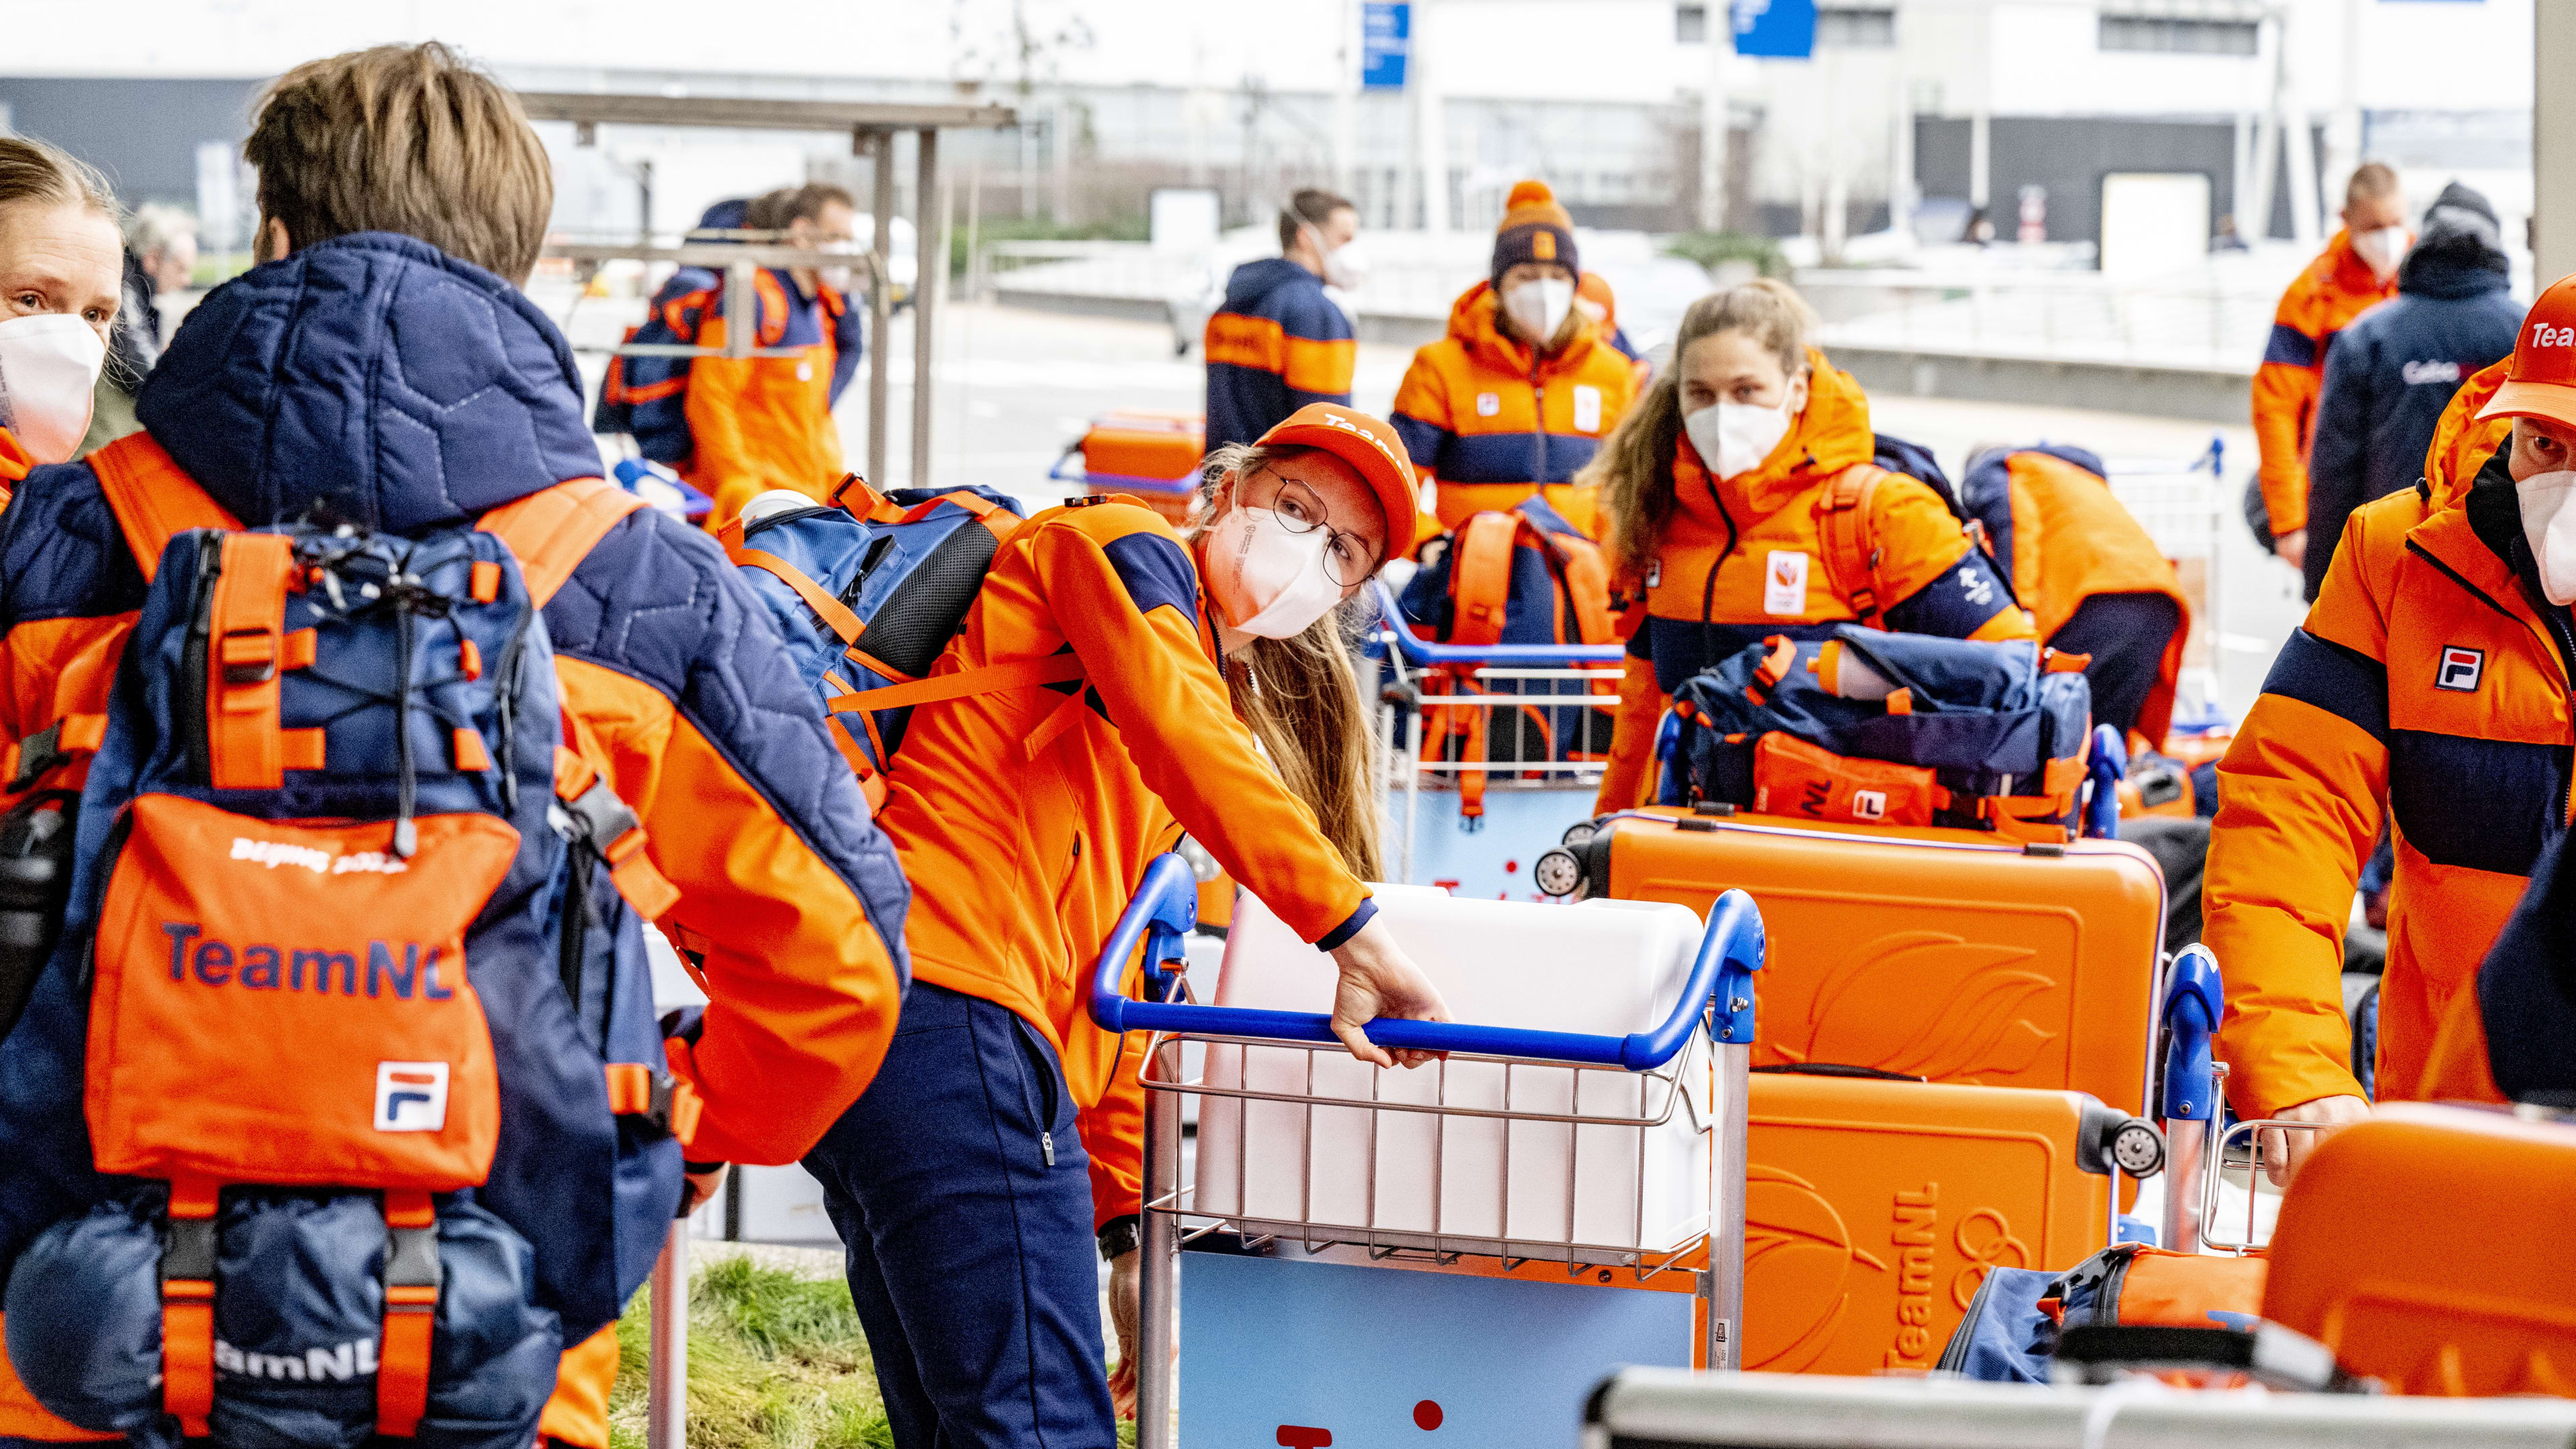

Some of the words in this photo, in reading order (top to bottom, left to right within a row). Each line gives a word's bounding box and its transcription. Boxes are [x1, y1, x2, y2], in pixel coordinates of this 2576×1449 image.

[2532, 323, 2576, 348] Tea
[1325, 413, 1407, 479] Team
[162, 922, 455, 1001] TeamNL
[214, 1338, 381, 1382] amNL
